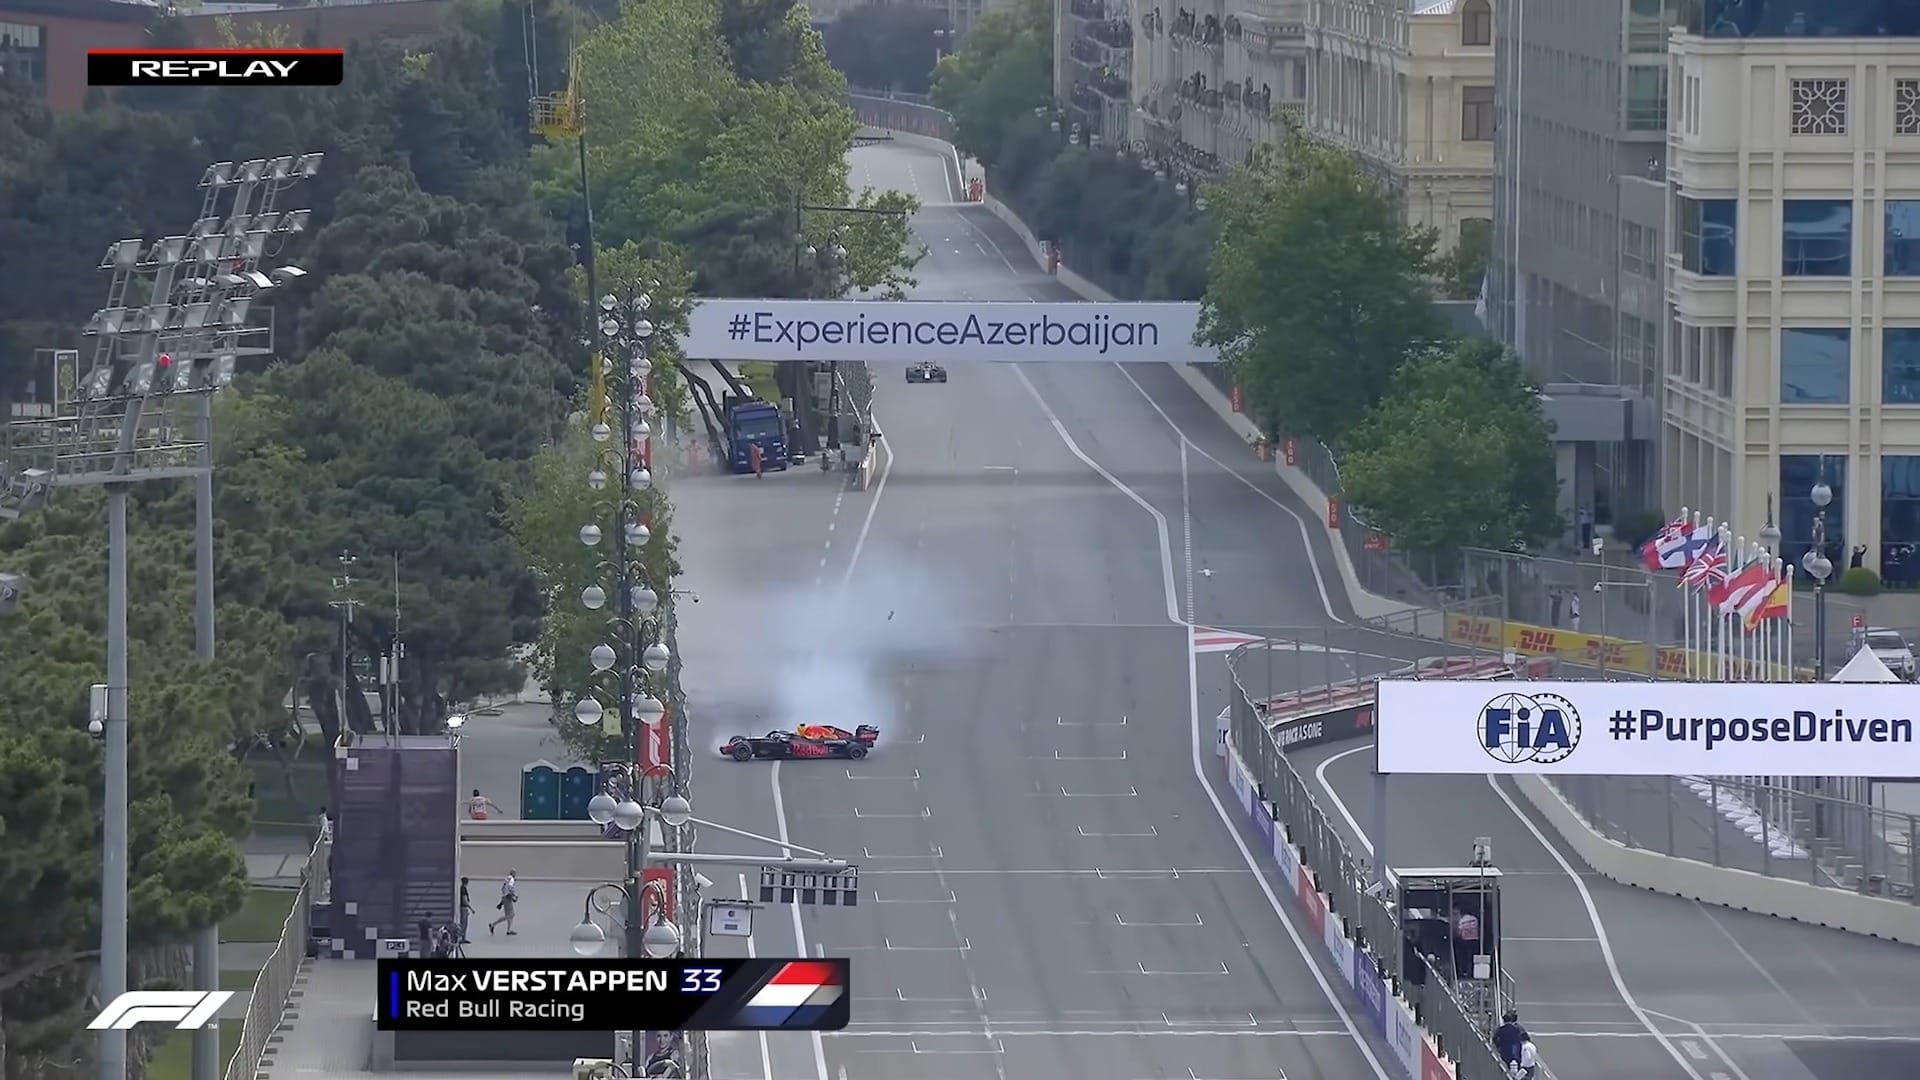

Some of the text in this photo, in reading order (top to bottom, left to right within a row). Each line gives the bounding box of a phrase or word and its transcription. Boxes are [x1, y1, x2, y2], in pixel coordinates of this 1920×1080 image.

[728, 313, 1158, 355] #ExperienceAzerbaijan
[1331, 504, 1337, 522] 50
[1518, 629, 1558, 653] DHL
[1610, 710, 1912, 750] #PurposeDriven
